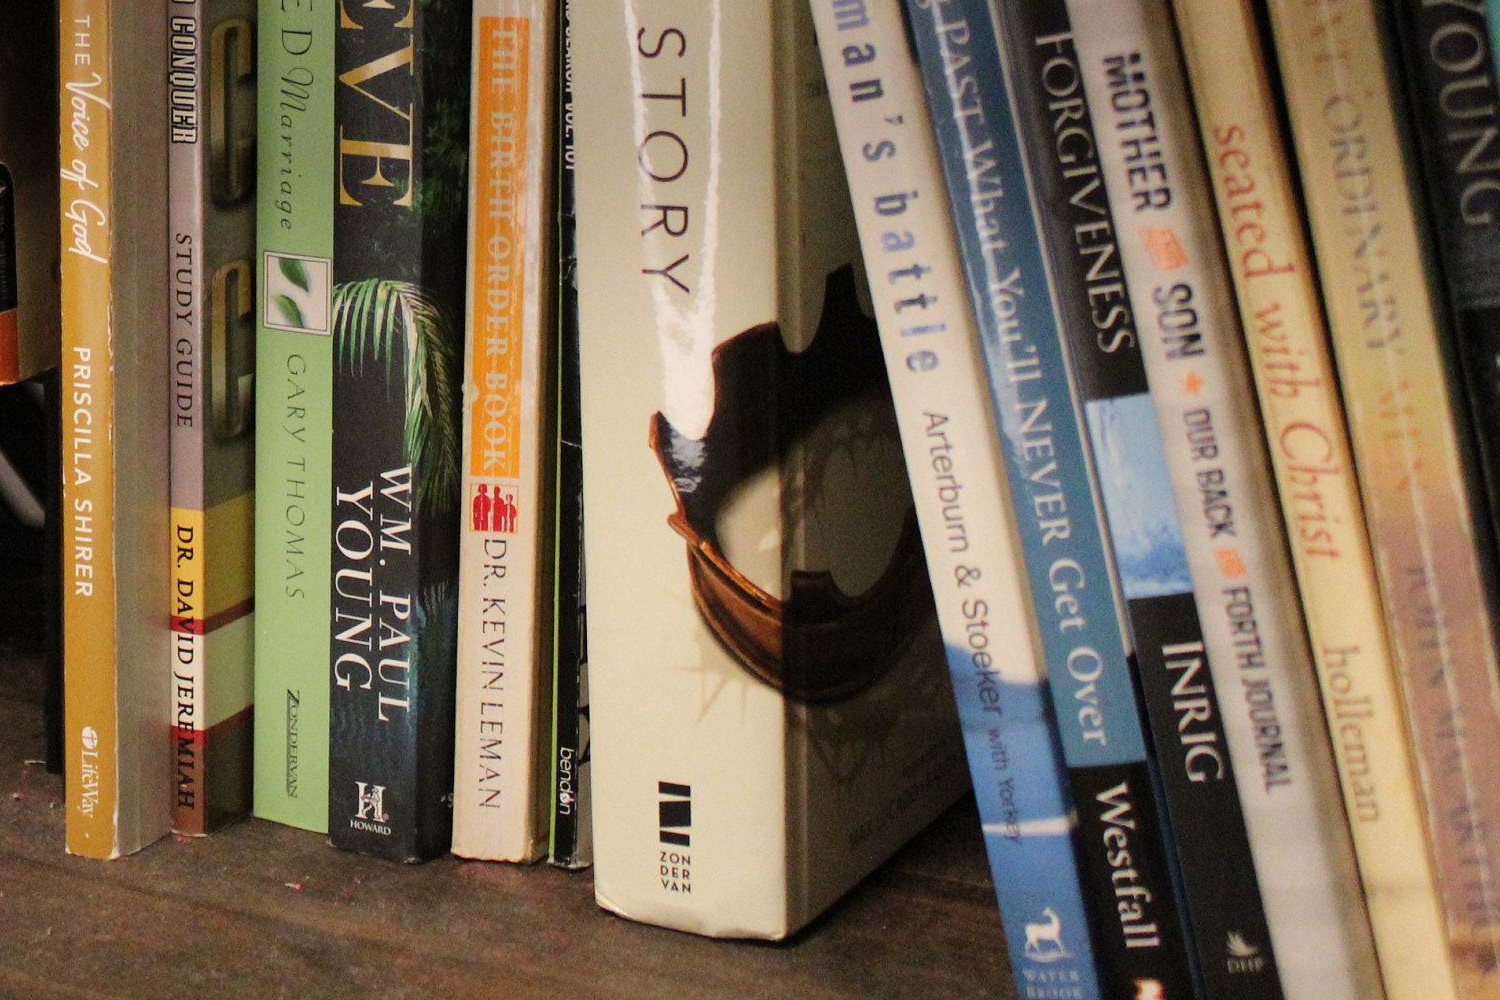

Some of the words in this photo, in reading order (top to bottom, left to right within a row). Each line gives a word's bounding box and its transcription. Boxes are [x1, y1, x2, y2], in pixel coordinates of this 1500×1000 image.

[73, 15, 91, 66] THE
[168, 15, 198, 145] CONQUER
[491, 28, 516, 95] THE
[934, 18, 986, 126] PAST
[64, 72, 112, 152] Voice
[275, 66, 315, 231] Marriage
[636, 27, 690, 294] STORY
[1103, 52, 1173, 213] MOTHER
[60, 157, 99, 191] of
[488, 110, 514, 220] BIRTH
[964, 139, 1008, 252] What
[1035, 30, 1136, 354] FORGIVENESS
[1213, 125, 1296, 279] seated
[65, 199, 109, 264] God
[175, 232, 193, 327] STUDY
[874, 190, 947, 374] battle
[485, 234, 511, 357] ORDER
[1152, 283, 1205, 362] SON
[176, 338, 193, 428] GUIDE
[282, 354, 307, 443] GARY
[1254, 302, 1322, 400] with
[73, 346, 92, 486] PRISCILLA
[483, 372, 508, 471] BOOK
[1182, 408, 1219, 463] OUR
[379, 462, 413, 567] WM.
[922, 410, 971, 554] Arterburn
[1014, 398, 1073, 548] NEVER
[1195, 468, 1238, 540] BACK
[1279, 421, 1342, 560] Christ
[74, 498, 93, 597] SHIRER
[176, 524, 194, 569] DR.
[285, 457, 306, 600] THOMAS
[483, 537, 507, 587] DR.
[953, 563, 982, 588] &
[177, 580, 194, 665] DAVID
[334, 480, 374, 692] YOUNG
[1049, 556, 1088, 635] Get
[1221, 585, 1266, 671] FORTH
[377, 589, 411, 722] PAUL
[481, 598, 506, 691] KEVIN
[961, 598, 1003, 716] Stoeker
[1066, 645, 1108, 747] Over
[173, 671, 195, 810] JEREMIAH
[286, 688, 300, 799] ZONDERVAN
[477, 701, 504, 809] LEMAN
[1161, 640, 1225, 785] INRIG
[1241, 676, 1293, 795] JOURNAL
[1321, 643, 1381, 825] holleman
[77, 750, 99, 819] LifeWay
[349, 818, 392, 837] HOWARD
[659, 850, 691, 866] ZON
[660, 864, 691, 881] DER
[660, 879, 692, 894] VAN
[1095, 780, 1161, 949] Westfall
